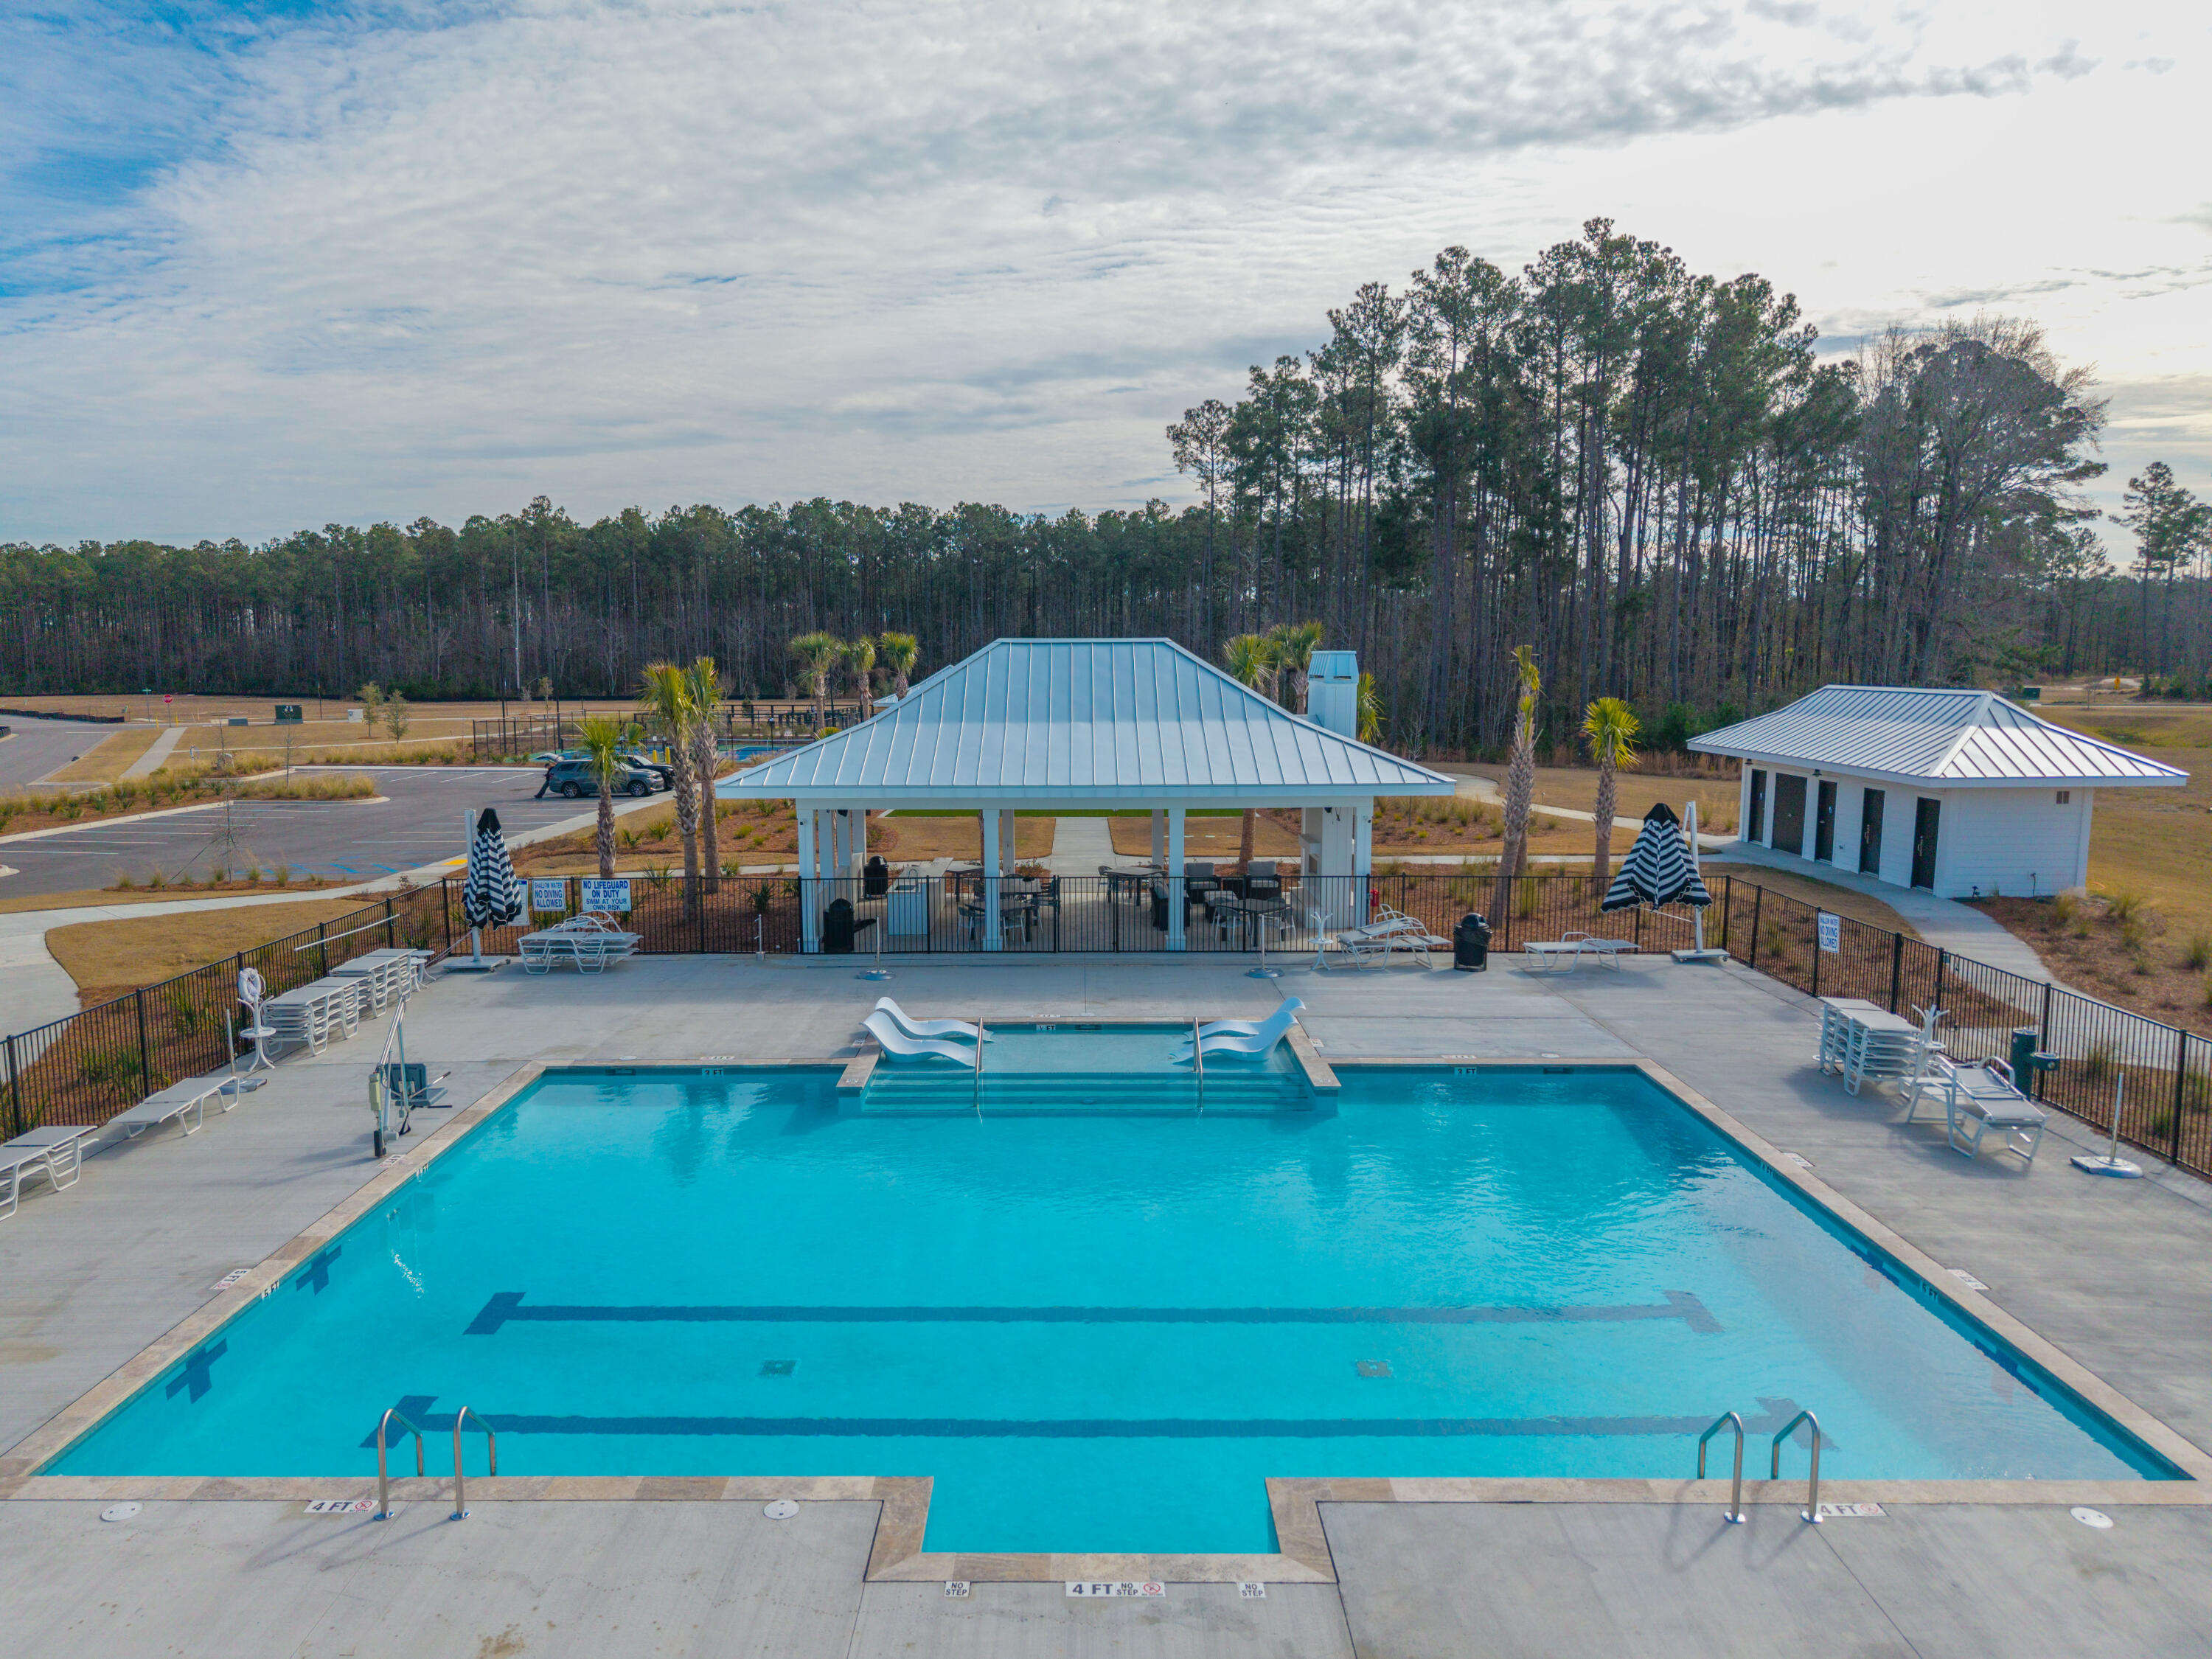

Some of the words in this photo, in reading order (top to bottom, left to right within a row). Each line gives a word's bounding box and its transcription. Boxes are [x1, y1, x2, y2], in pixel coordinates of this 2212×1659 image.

[583, 881, 591, 889] NO
[594, 880, 628, 889] LIFEGUARD
[535, 890, 543, 898] NO
[544, 890, 563, 898] DIVING
[591, 890, 600, 898] ON
[536, 899, 563, 908] ALLOWED
[1820, 925, 1825, 935] NO
[1826, 926, 1837, 938] DIVING
[1821, 937, 1837, 949] ALLOWED
[271, 1279, 279, 1293] FT
[313, 1502, 326, 1511] 4
[329, 1501, 353, 1511] FT
[1820, 1505, 1832, 1514] 4
[1834, 1505, 1857, 1514] FT
[1072, 1584, 1084, 1594] 4
[1092, 1584, 1113, 1595] FT
